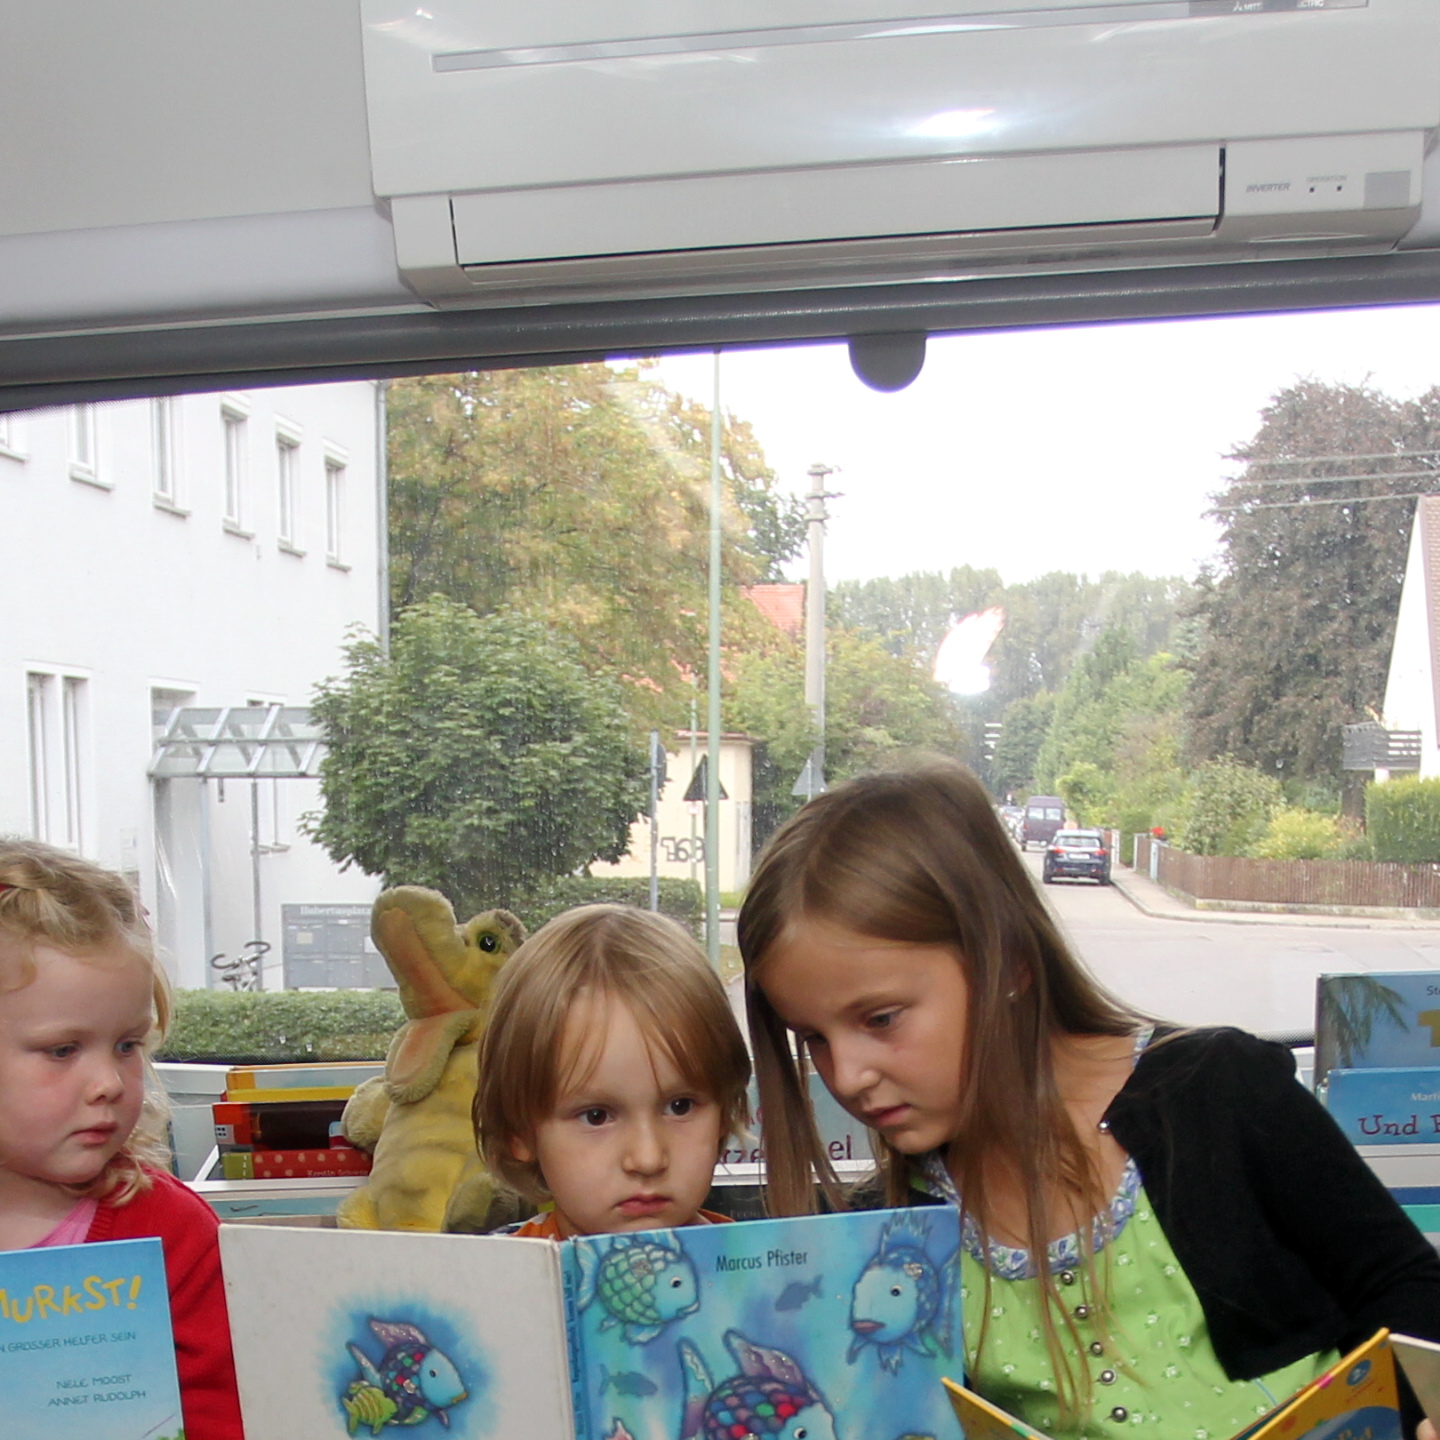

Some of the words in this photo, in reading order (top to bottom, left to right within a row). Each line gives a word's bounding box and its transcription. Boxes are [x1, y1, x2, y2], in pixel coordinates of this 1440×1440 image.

[1246, 182, 1291, 194] INVERTER
[1358, 1113, 1419, 1137] Und
[716, 1253, 763, 1273] Marcus
[766, 1249, 808, 1268] Pfister
[7, 1337, 62, 1353] GROSSER
[63, 1332, 108, 1348] HELFER
[110, 1330, 137, 1343] SEIN
[56, 1377, 89, 1391] NELE
[92, 1373, 133, 1387] MOOST
[47, 1393, 90, 1408] ANNET
[93, 1389, 147, 1404] RUDOLPH
